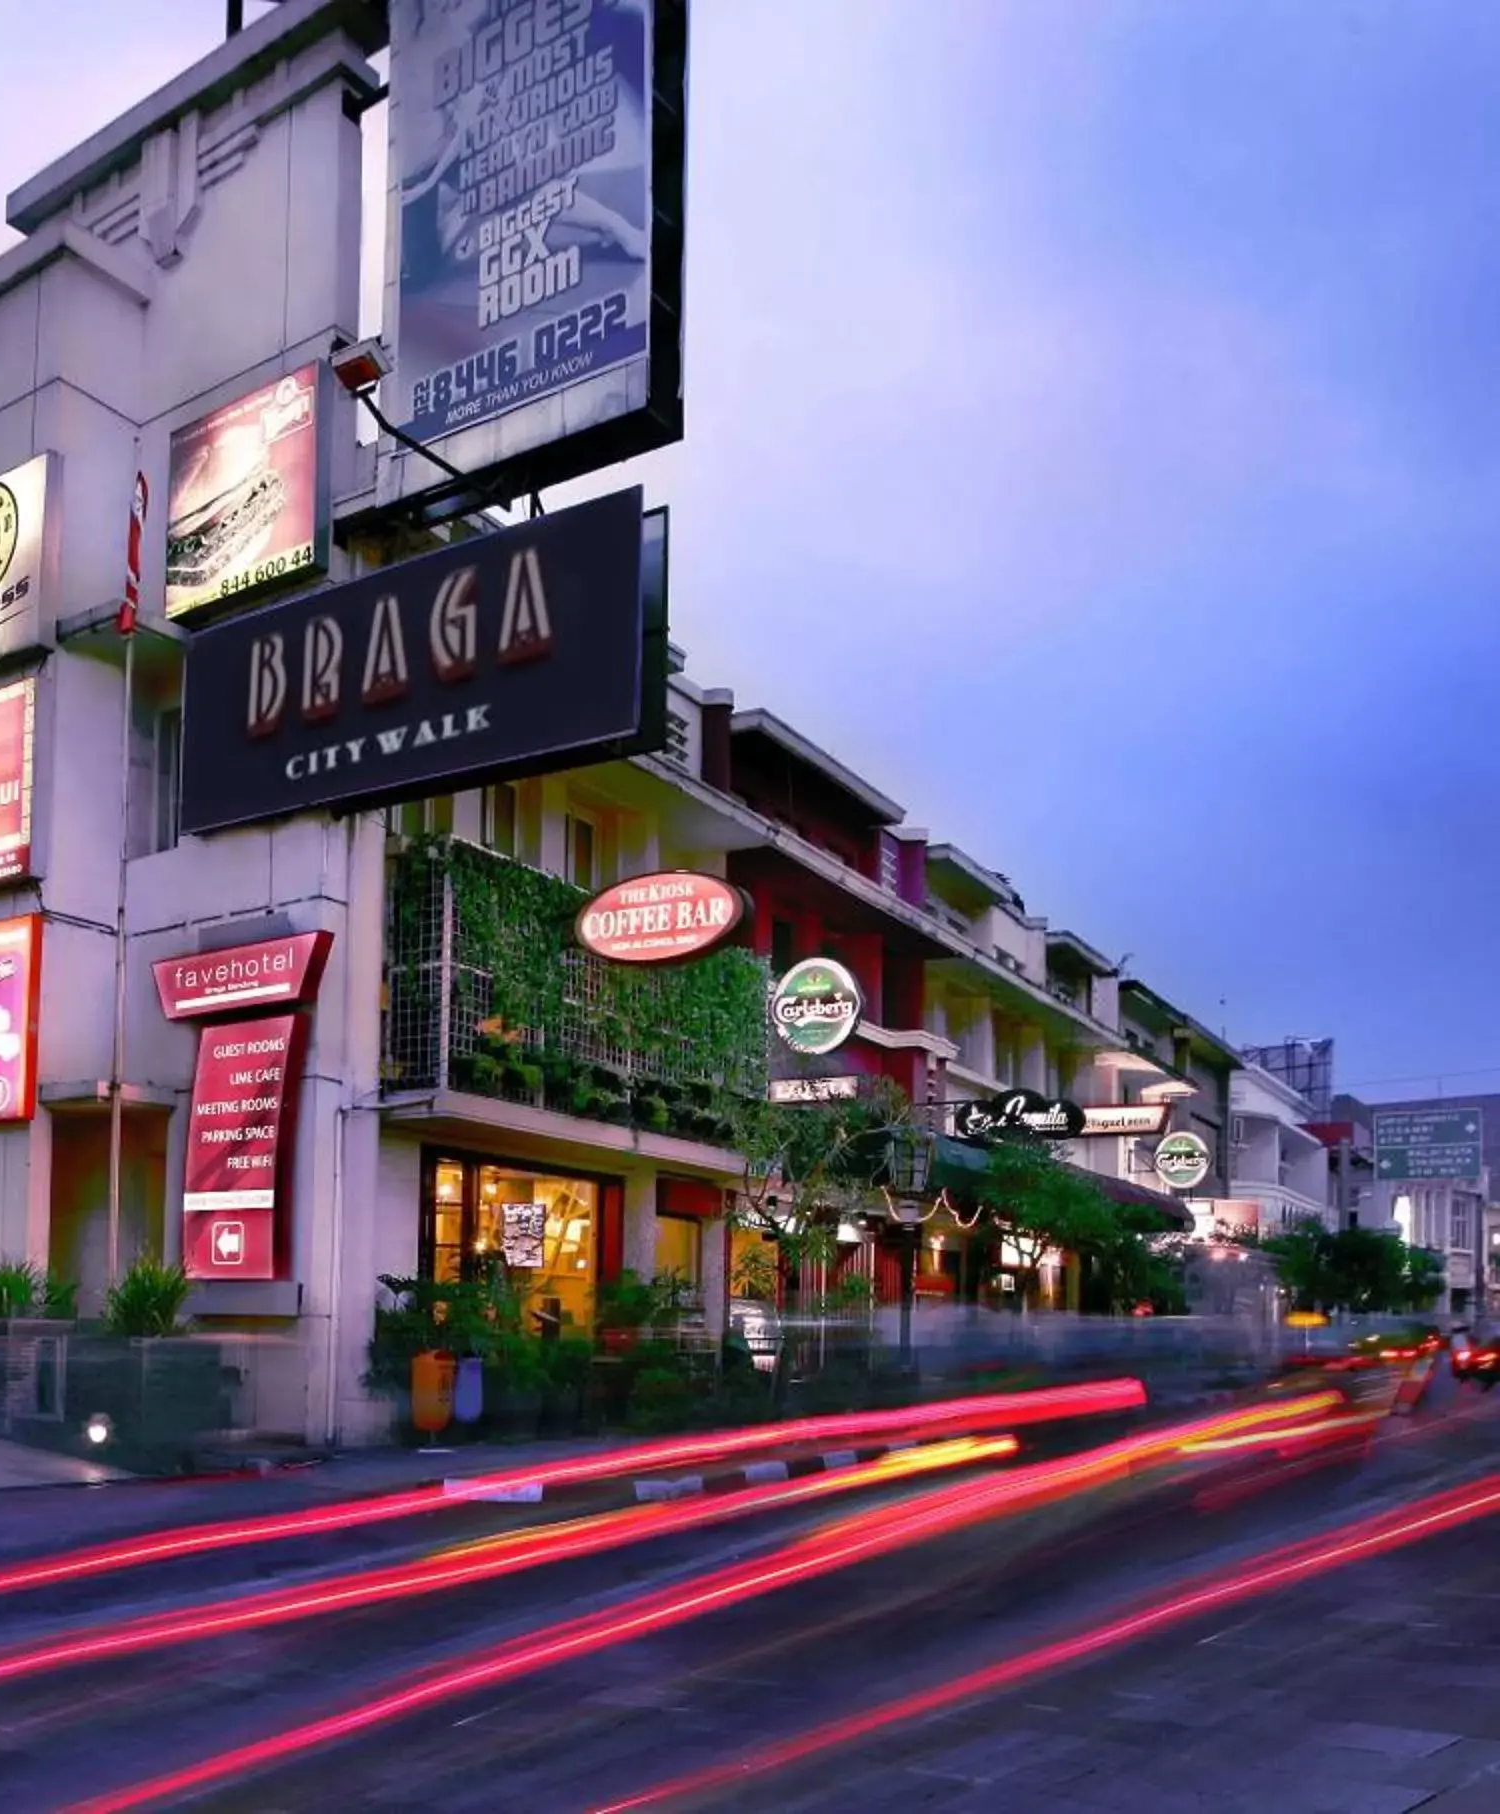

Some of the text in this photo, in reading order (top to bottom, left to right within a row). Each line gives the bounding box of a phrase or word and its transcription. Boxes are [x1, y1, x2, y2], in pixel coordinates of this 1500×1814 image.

[434, 0, 615, 106] BIGGES
[508, 22, 590, 97] MOST
[459, 44, 613, 160] LUXURIOUS
[480, 116, 615, 213] BANDUNG
[480, 176, 578, 249] BIGGEST
[479, 246, 579, 328] ROOM
[432, 294, 626, 409] 8446 0222
[446, 352, 593, 424] MORE THAN YOU KNOW
[221, 546, 311, 597] 844 600 44
[247, 547, 552, 736] BRAGA
[582, 897, 725, 939] COFFEE BAR
[620, 881, 694, 904] THE KIOSK
[176, 947, 293, 988] favehotel
[776, 992, 853, 1026] Carlsberg
[213, 1038, 285, 1060] GUEST ROOMS
[229, 1067, 281, 1085] LIME CAFE
[197, 1097, 277, 1115] MEETING ROOMS
[201, 1125, 275, 1143] PARKING SPACE
[227, 1156, 250, 1169] FREE
